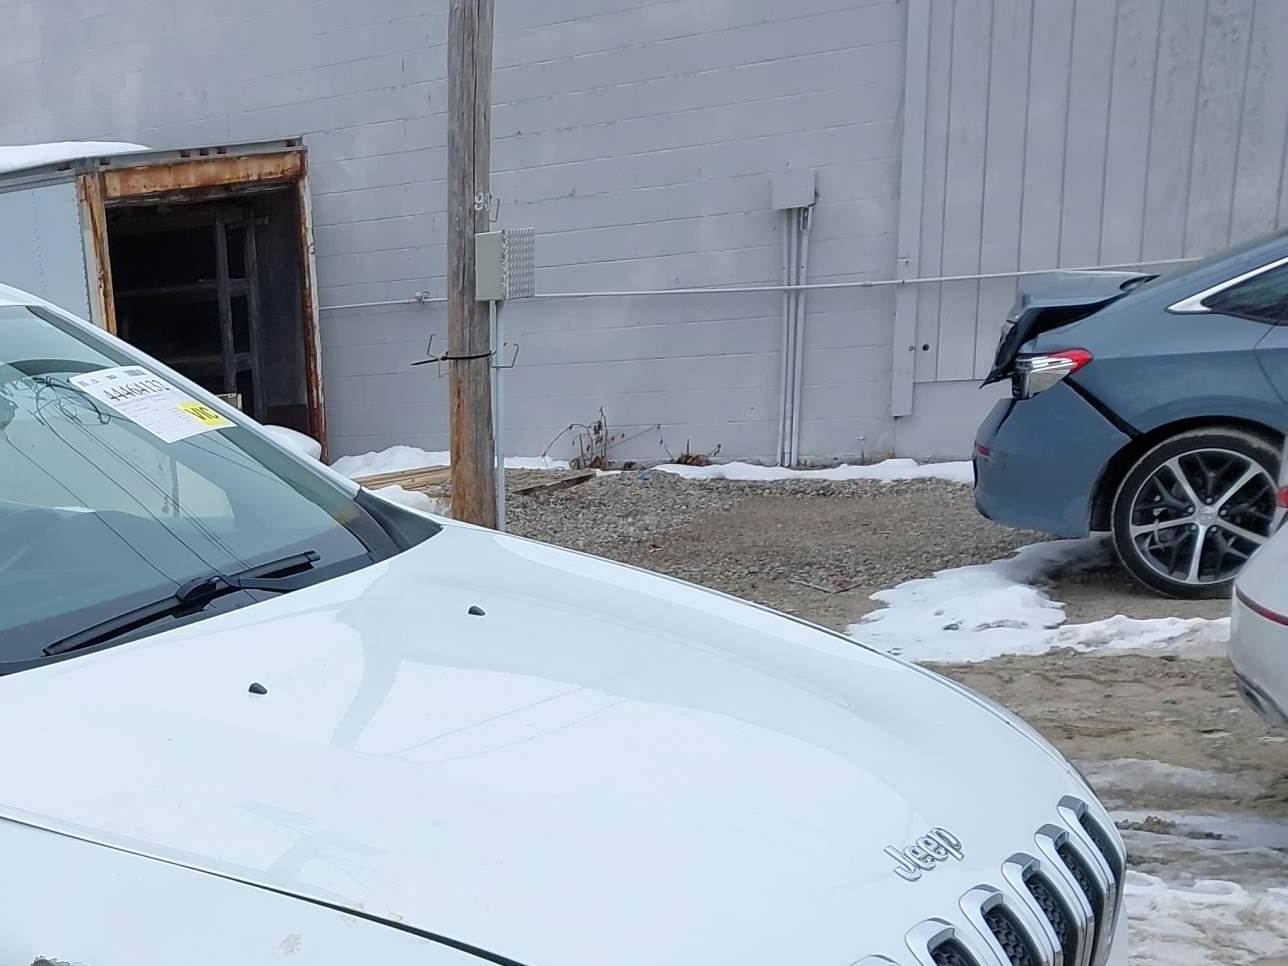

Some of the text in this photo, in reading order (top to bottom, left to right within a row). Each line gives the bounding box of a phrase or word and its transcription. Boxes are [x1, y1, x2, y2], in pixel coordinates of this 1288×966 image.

[103, 379, 170, 402] 44464132
[184, 406, 220, 421] VIC
[883, 825, 965, 882] Jeep
